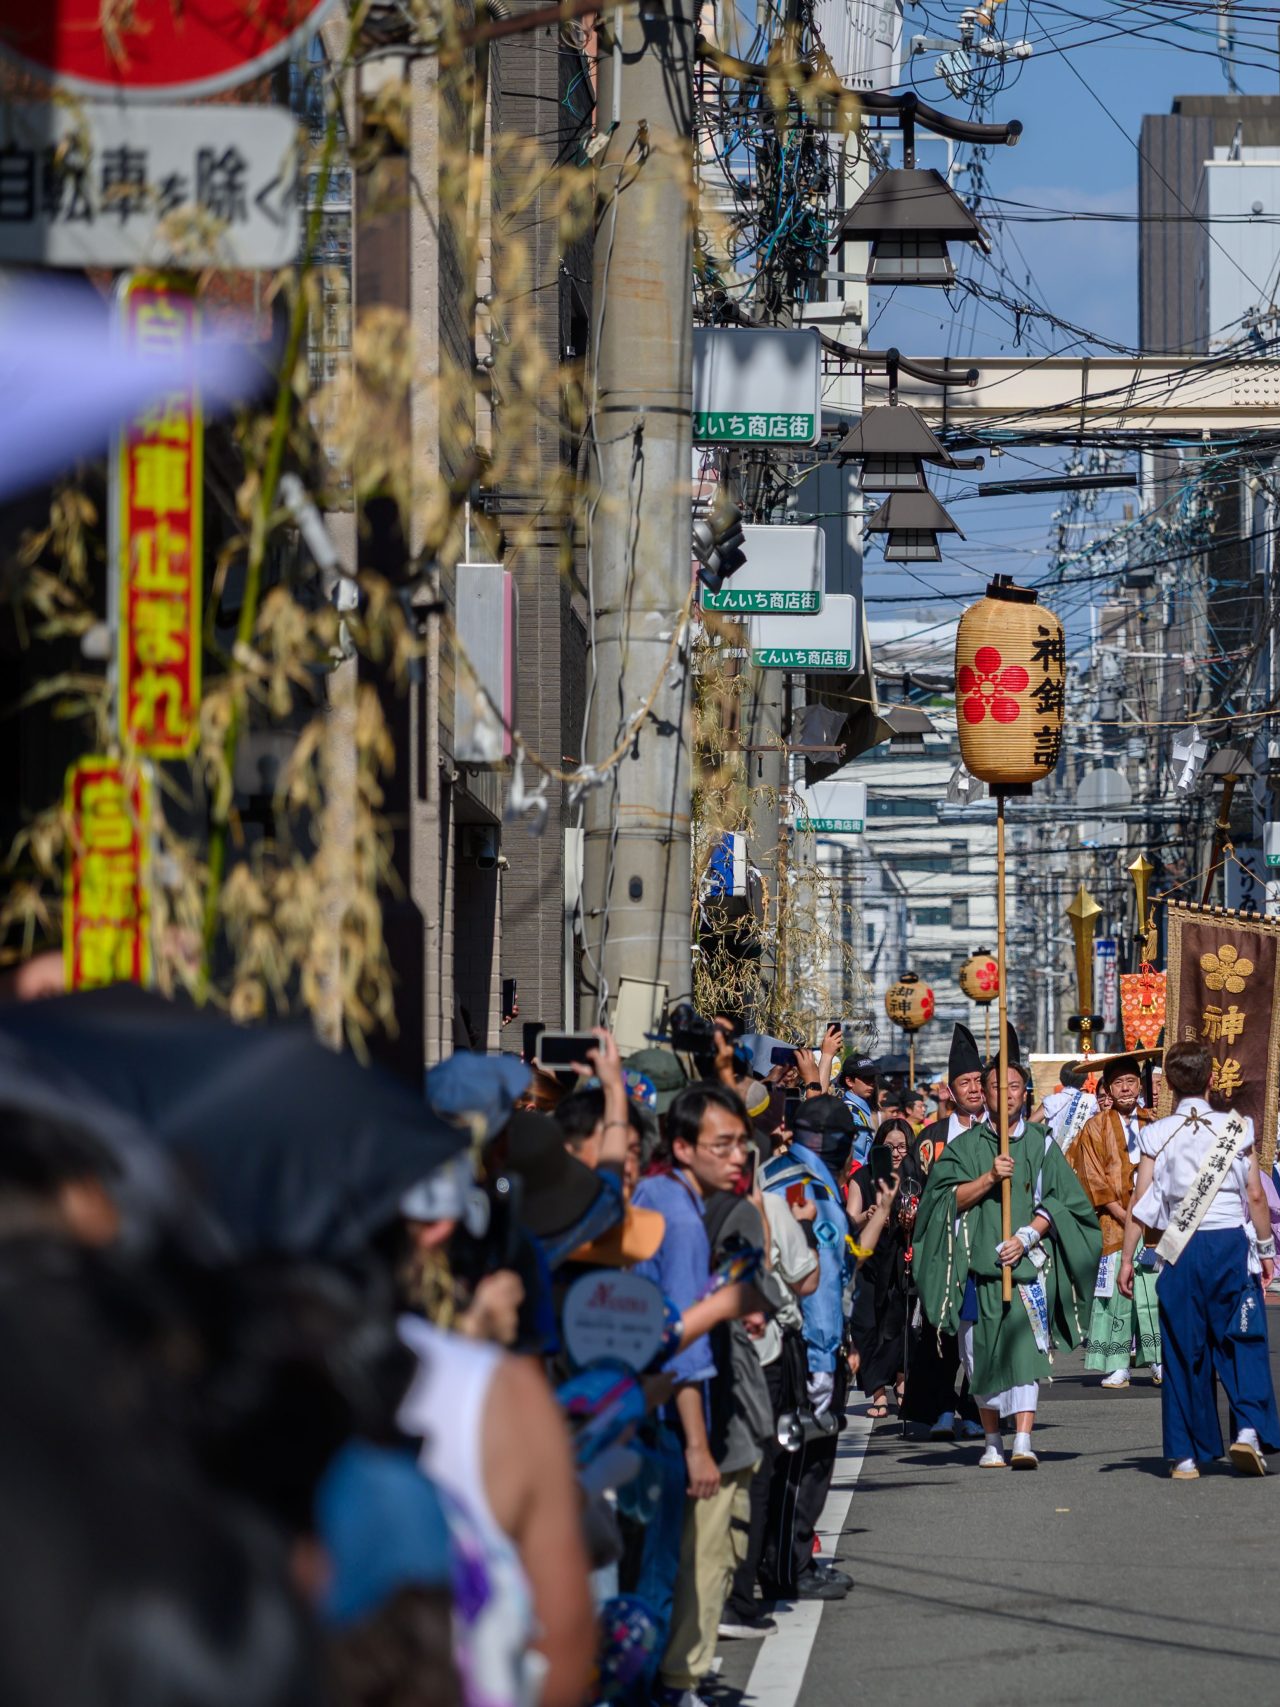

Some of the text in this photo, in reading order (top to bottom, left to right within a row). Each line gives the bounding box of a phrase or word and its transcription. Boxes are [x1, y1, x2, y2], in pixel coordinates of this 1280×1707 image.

[707, 592, 816, 609] てんいち商店街
[755, 651, 848, 665] てんいち商店街
